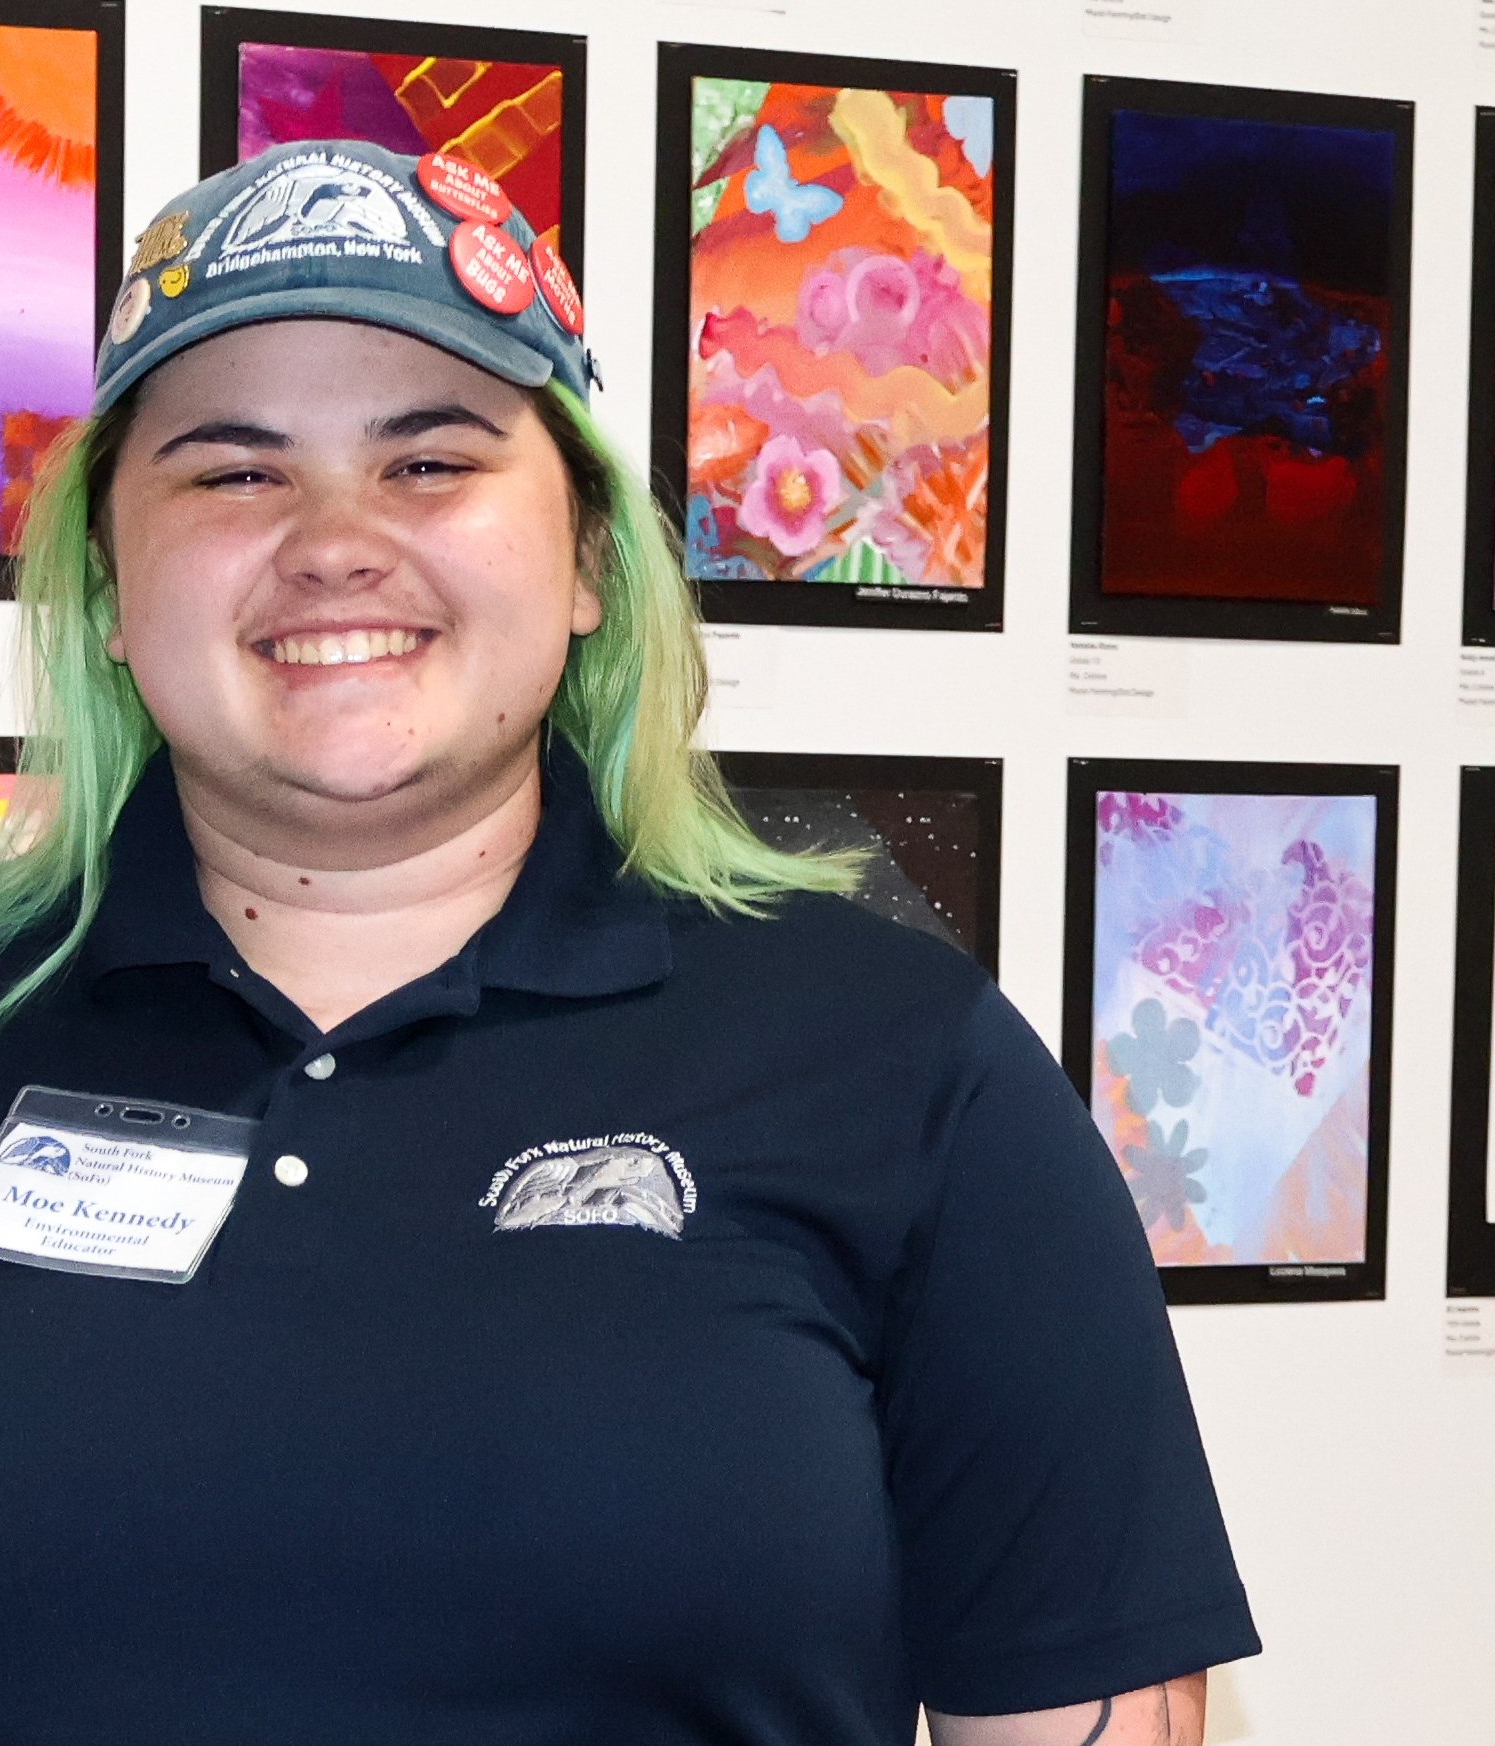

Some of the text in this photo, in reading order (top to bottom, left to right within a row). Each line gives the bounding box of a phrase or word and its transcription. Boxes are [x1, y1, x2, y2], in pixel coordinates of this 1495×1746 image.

[344, 240, 381, 257] New
[383, 243, 423, 264] York
[472, 226, 506, 258] ASK
[506, 254, 530, 283] ME
[466, 258, 507, 303] BUGS
[82, 1142, 153, 1161] South Fork
[543, 1134, 609, 1155] Natural
[75, 1156, 235, 1187] Natural History Museum
[2, 1185, 196, 1235] Moe Kennedy
[564, 1209, 618, 1224] SOFO
[24, 1216, 150, 1246] Environmental
[41, 1237, 117, 1257] Educator
